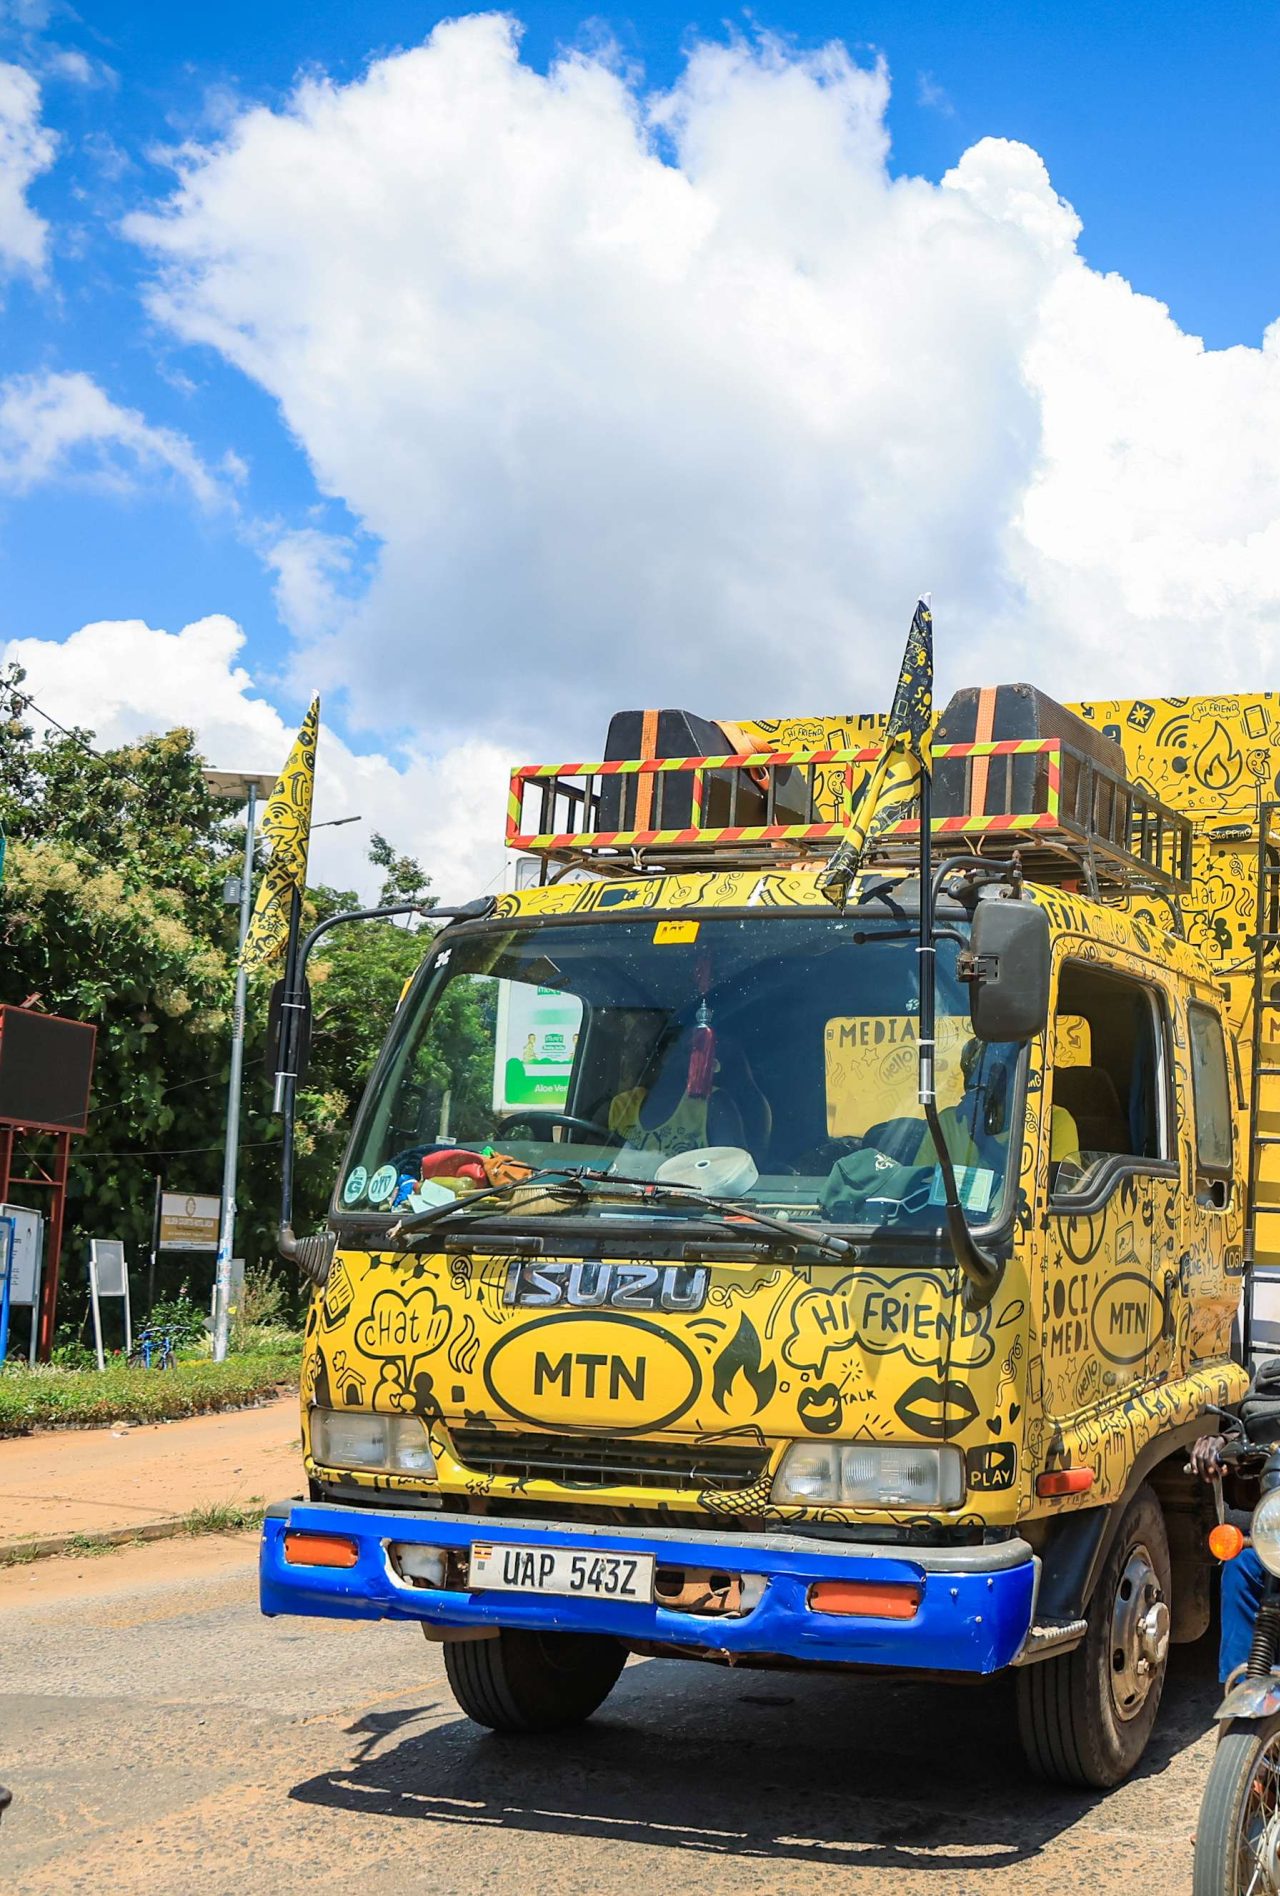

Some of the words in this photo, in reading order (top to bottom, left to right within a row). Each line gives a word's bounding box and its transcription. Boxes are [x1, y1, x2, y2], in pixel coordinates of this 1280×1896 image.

[839, 1018, 917, 1048] MEDIA
[534, 1084, 553, 1093] Aloe
[505, 1262, 709, 1311] ISUZU
[1109, 1301, 1148, 1336] MTN
[533, 1350, 647, 1402] MTN
[839, 1388, 878, 1412] TALK
[970, 1467, 1011, 1488] PLAY
[503, 1552, 554, 1589] UAP
[571, 1555, 637, 1596] 543Z
